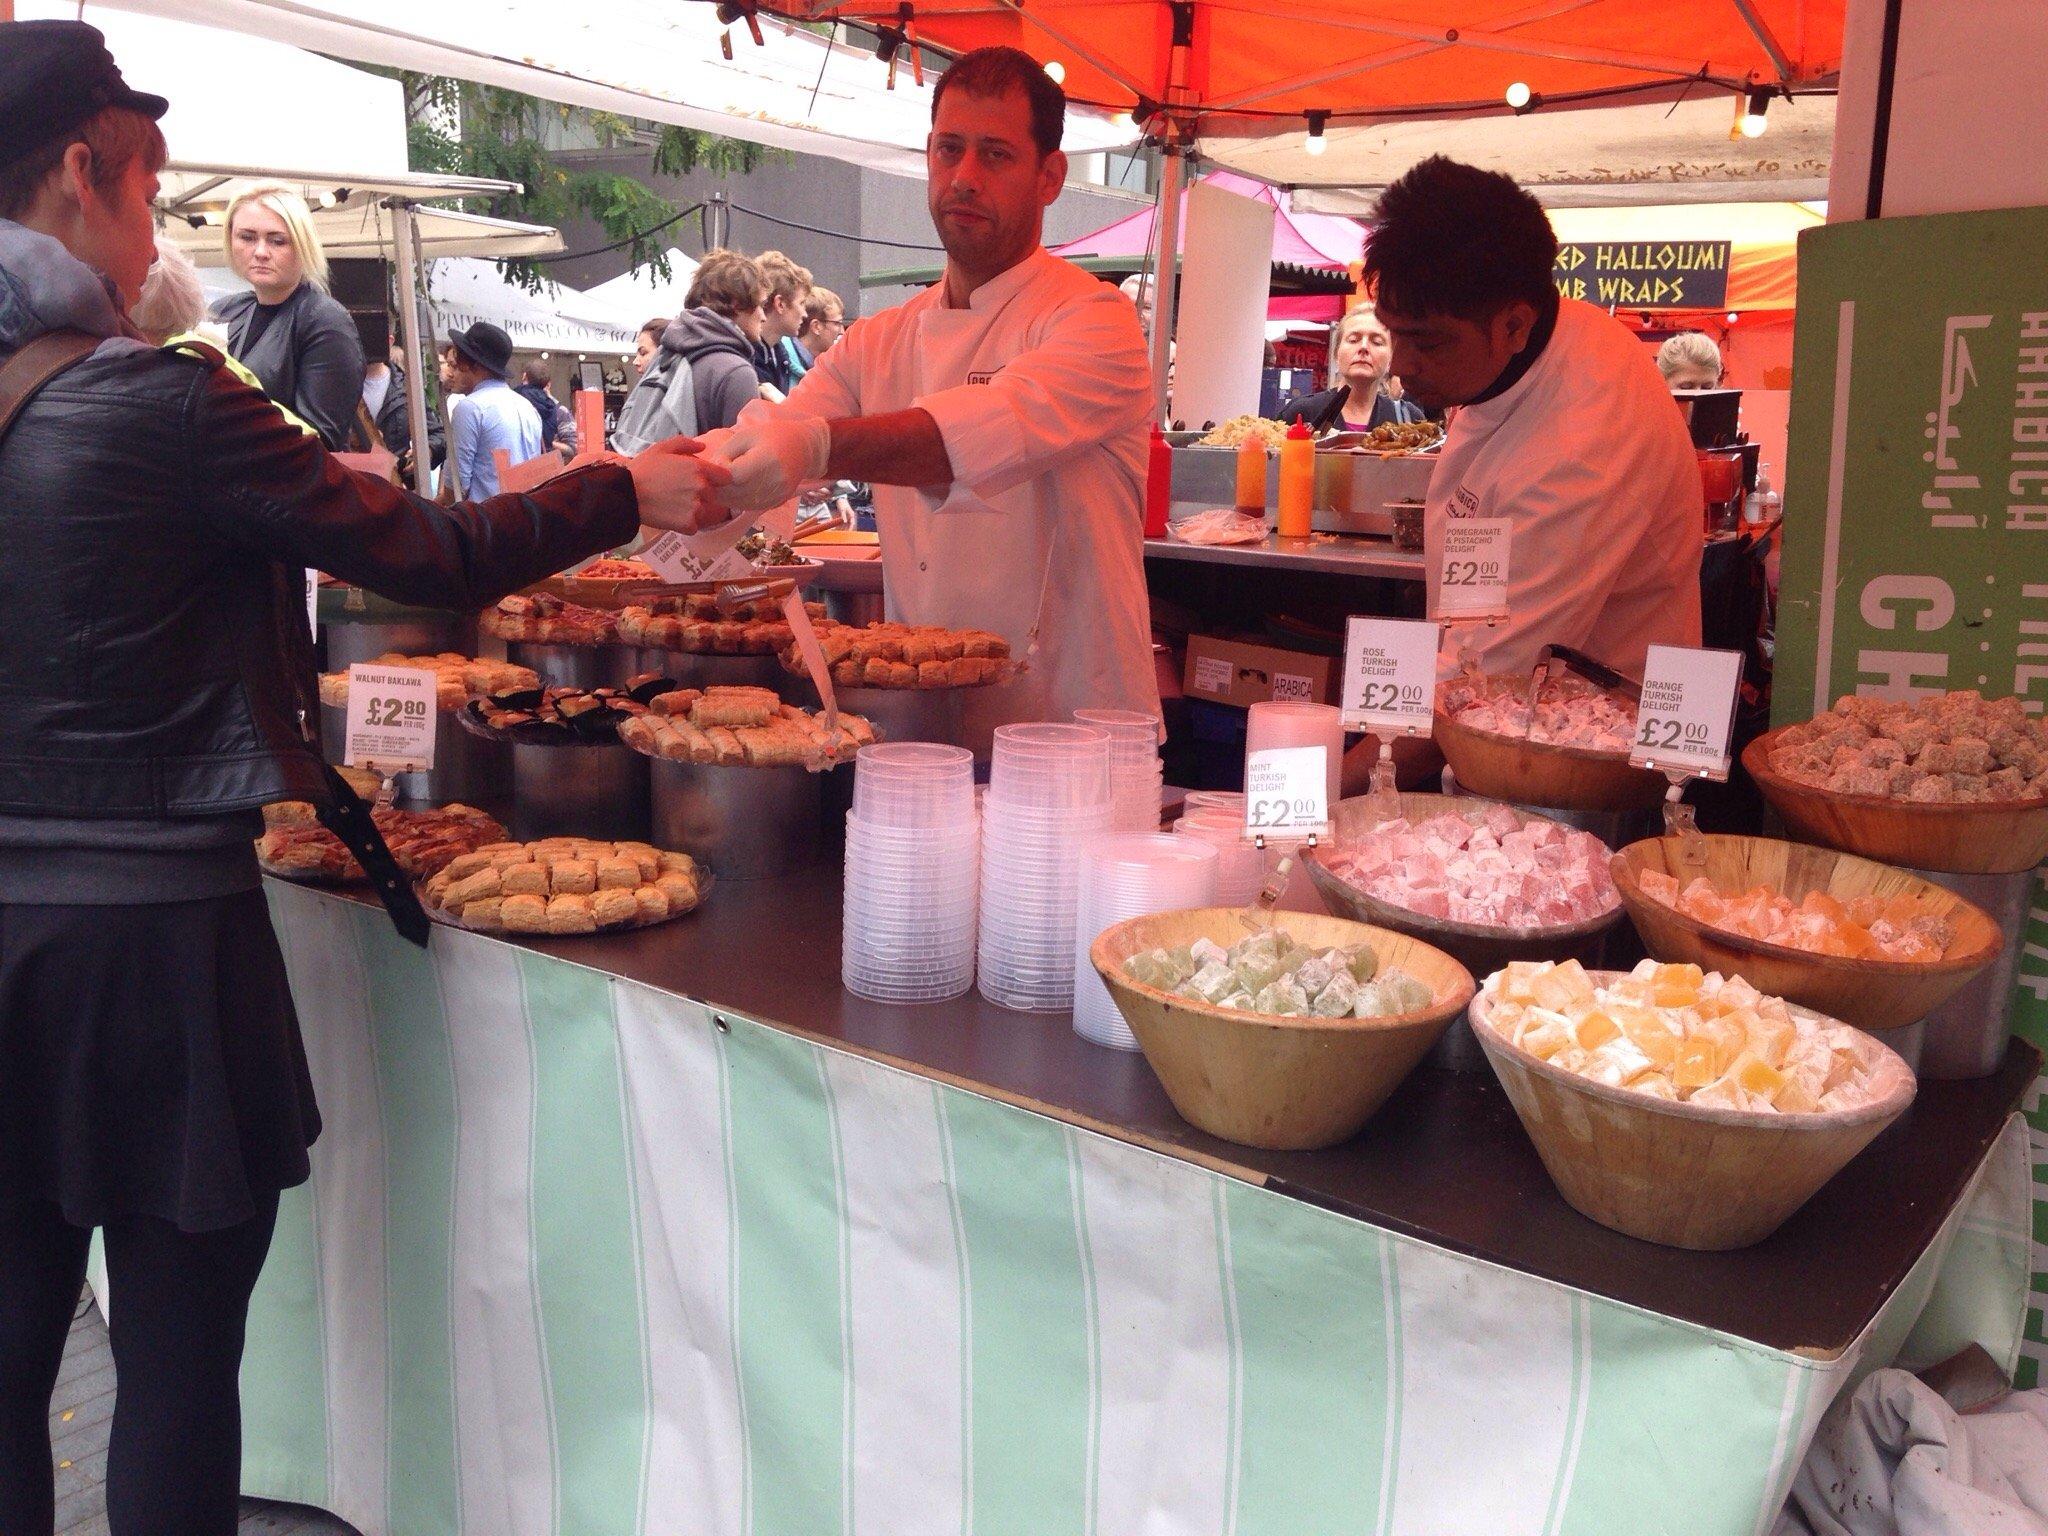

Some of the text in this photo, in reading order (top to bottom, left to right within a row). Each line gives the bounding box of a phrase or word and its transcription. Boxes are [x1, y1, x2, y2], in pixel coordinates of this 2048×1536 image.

[1595, 244, 1725, 271] HALLOUMI
[1598, 276, 1684, 303] WRAPS
[1446, 528, 1502, 536] POMEGRANATE
[1445, 536, 1493, 544] & PISTACHIO
[1445, 545, 1476, 553] DELIGHT
[1362, 647, 1386, 657] ROSE
[1362, 656, 1398, 667] TURKISH
[1361, 666, 1396, 676] DELIGHT
[355, 674, 422, 687] WALNUT BAKLAWA
[1274, 678, 1313, 697] ARABICA
[1645, 680, 1684, 692] ORANGE
[1643, 690, 1683, 702] TURKISH
[1401, 705, 1414, 713] PER
[1642, 700, 1680, 712] DELIGHT
[1683, 744, 1697, 753] PER
[1249, 763, 1272, 772] MINT
[1249, 773, 1287, 782] TURKISH
[1249, 783, 1285, 792] DELIGHT
